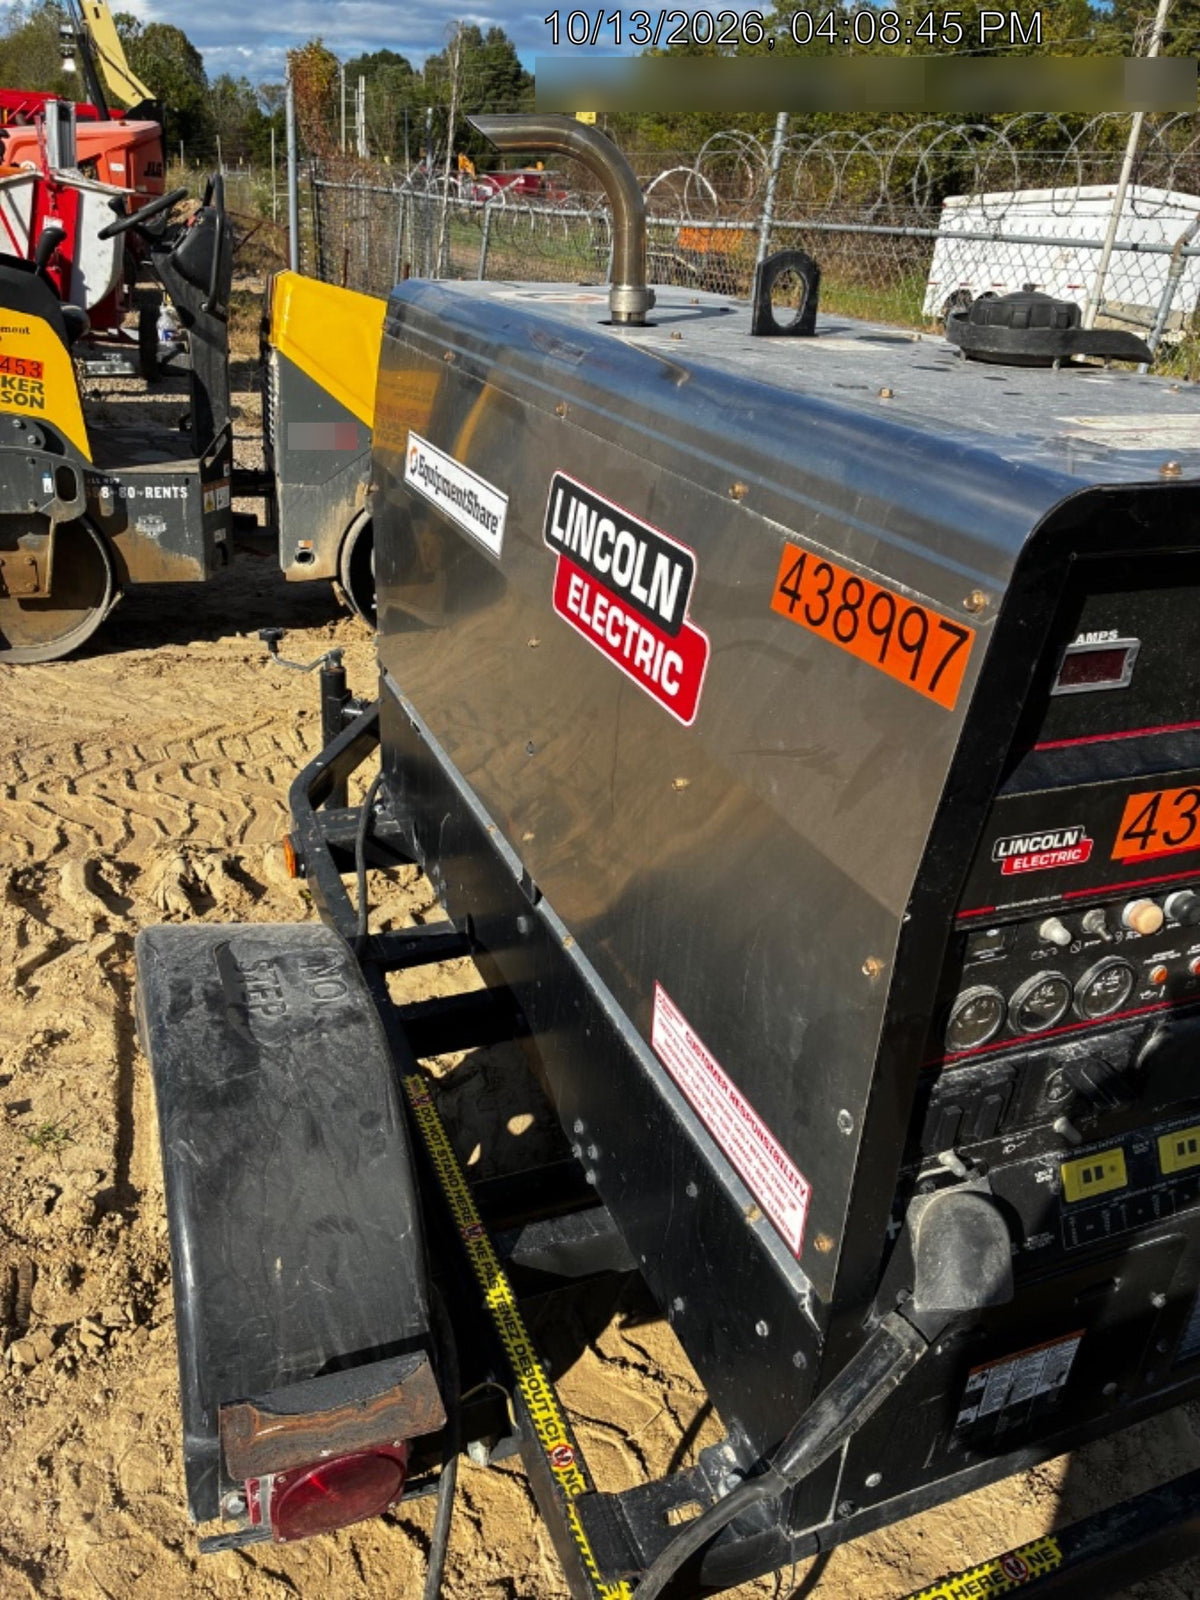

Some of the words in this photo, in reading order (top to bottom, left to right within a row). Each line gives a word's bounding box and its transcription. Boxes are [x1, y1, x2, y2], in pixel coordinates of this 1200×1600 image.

[0, 375, 44, 396] KER
[0, 390, 45, 410] SON
[418, 453, 500, 536] EquipmentShare
[550, 488, 684, 623] LINCOLN
[566, 573, 684, 696] ELECTRIC
[779, 552, 970, 693] 438997
[1075, 629, 1119, 645] AMPS
[997, 830, 1079, 857] LINCOLN
[1122, 787, 1200, 850] 43
[1012, 849, 1082, 870] ELECTRIC
[728, 1090, 807, 1197] RESPONSIBILITY
[436, 1149, 460, 1188] STAND
[450, 1189, 474, 1223] HERE
[481, 1262, 499, 1289] PAS
[493, 1292, 522, 1342] TENEZ
[513, 1343, 551, 1414] DEBOUT
[543, 1416, 561, 1442] ICI
[950, 1568, 1005, 1600] HERE
[1025, 1547, 1056, 1568] NE
